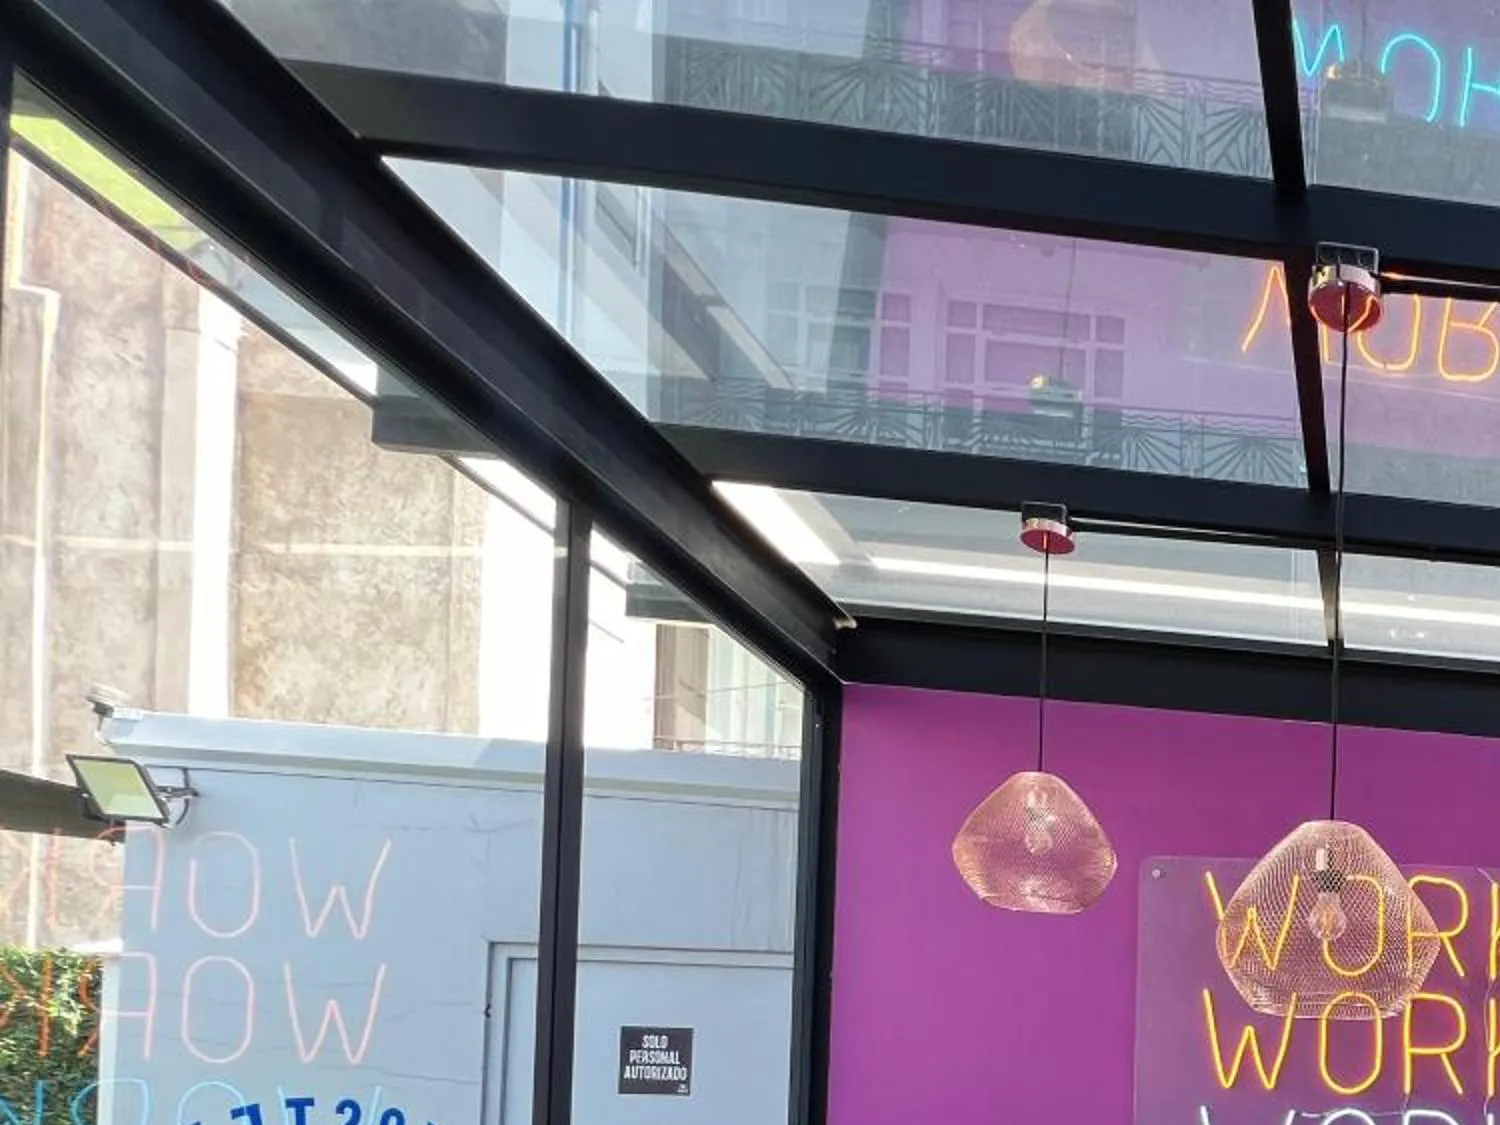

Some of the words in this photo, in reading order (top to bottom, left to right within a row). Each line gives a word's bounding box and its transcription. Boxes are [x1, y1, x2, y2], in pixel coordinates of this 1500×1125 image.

[641, 1035, 669, 1049] SOLO
[629, 1049, 681, 1065] PERSONAL
[623, 1065, 688, 1081] AUTORIZADO
